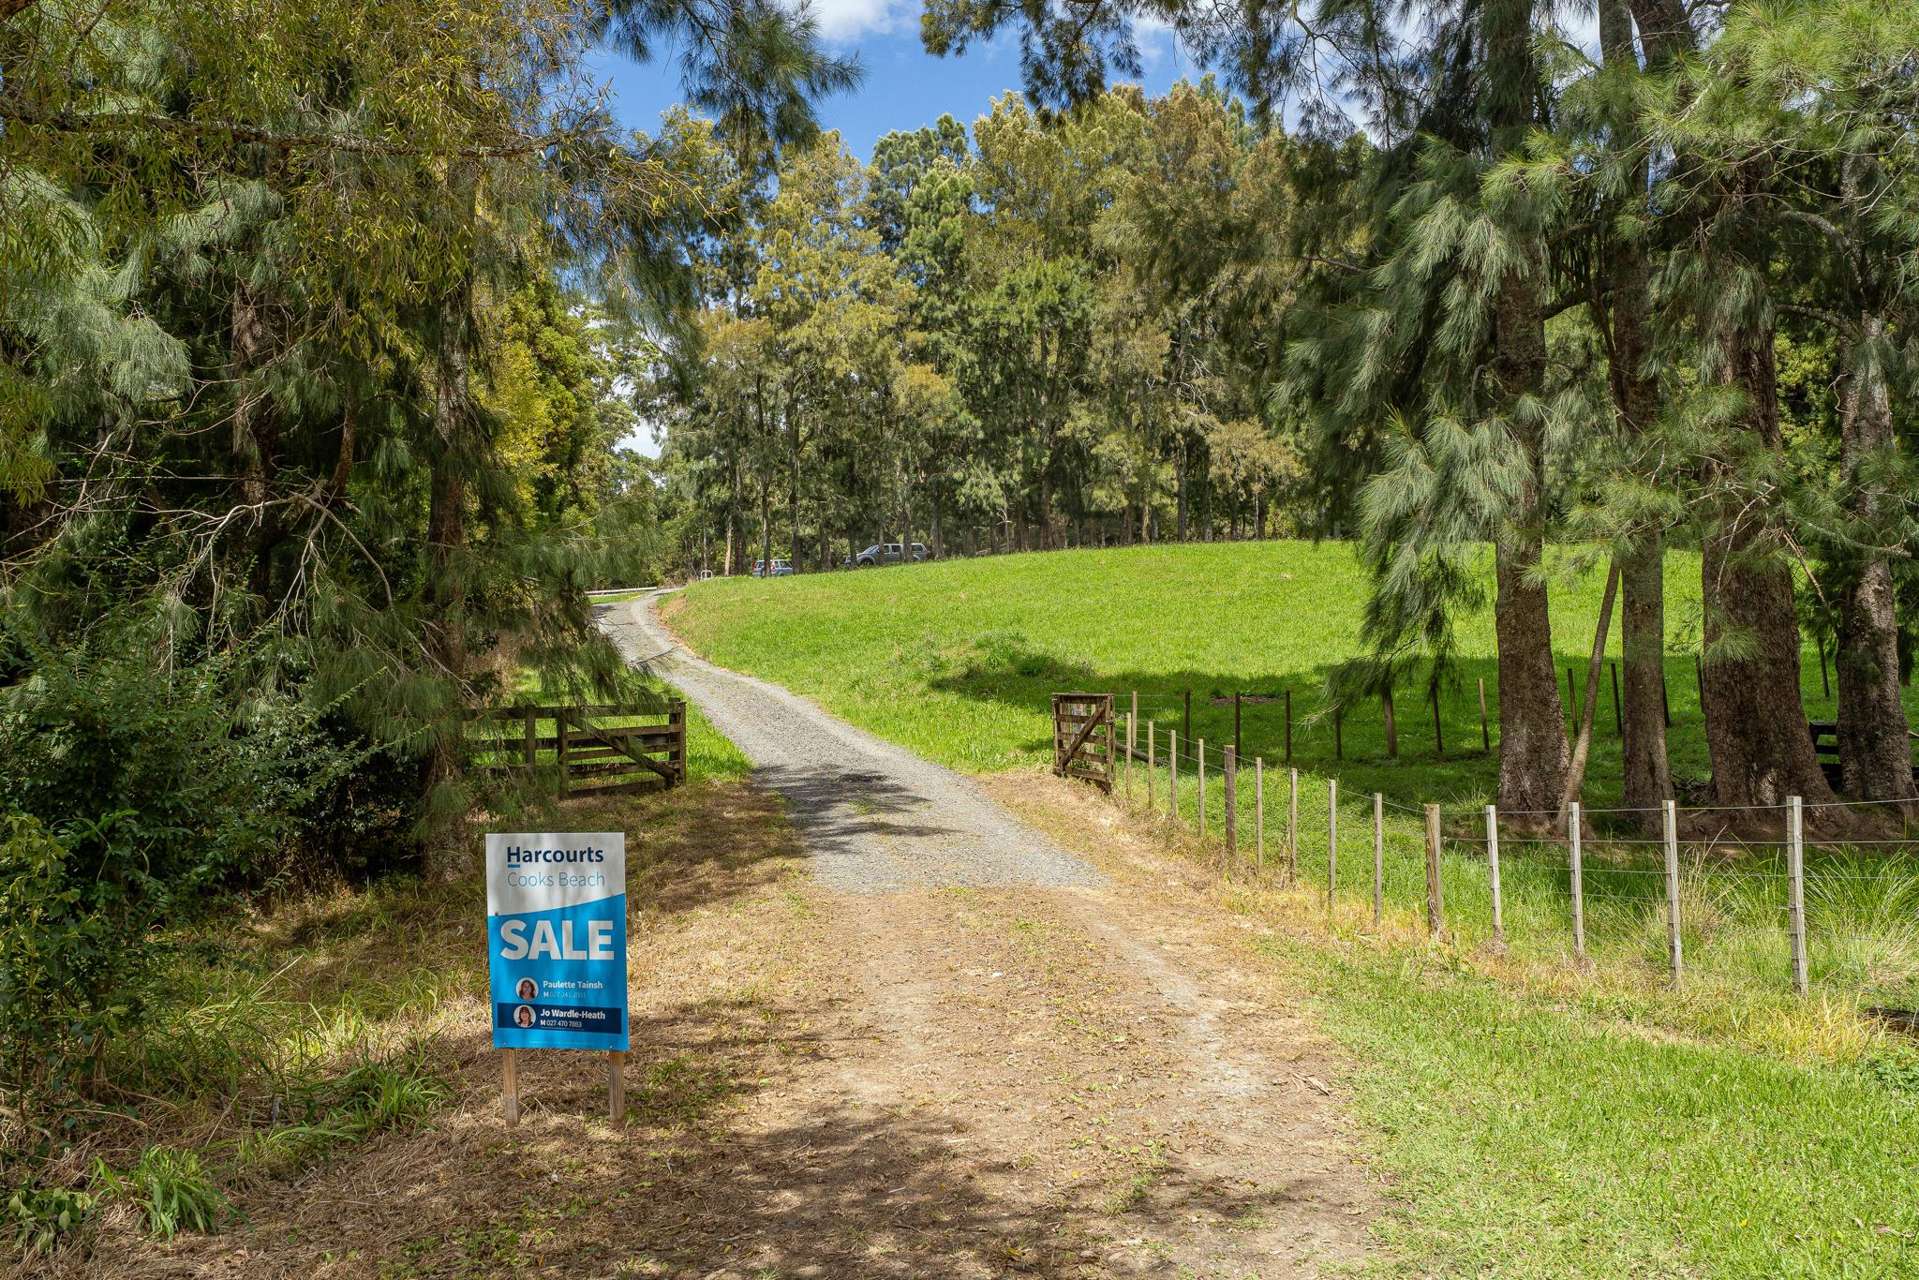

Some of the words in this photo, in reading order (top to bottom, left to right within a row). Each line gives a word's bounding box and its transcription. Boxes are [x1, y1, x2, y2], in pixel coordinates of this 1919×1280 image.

[507, 846, 604, 863] Harcourts
[507, 871, 554, 887] Cooks
[559, 871, 605, 887] Beach
[500, 919, 615, 961] SALE
[543, 980, 576, 989] Paulette
[577, 980, 603, 989] Tainsh
[540, 1009, 550, 1017] Jo
[551, 1009, 606, 1020] Wardle-Heath
